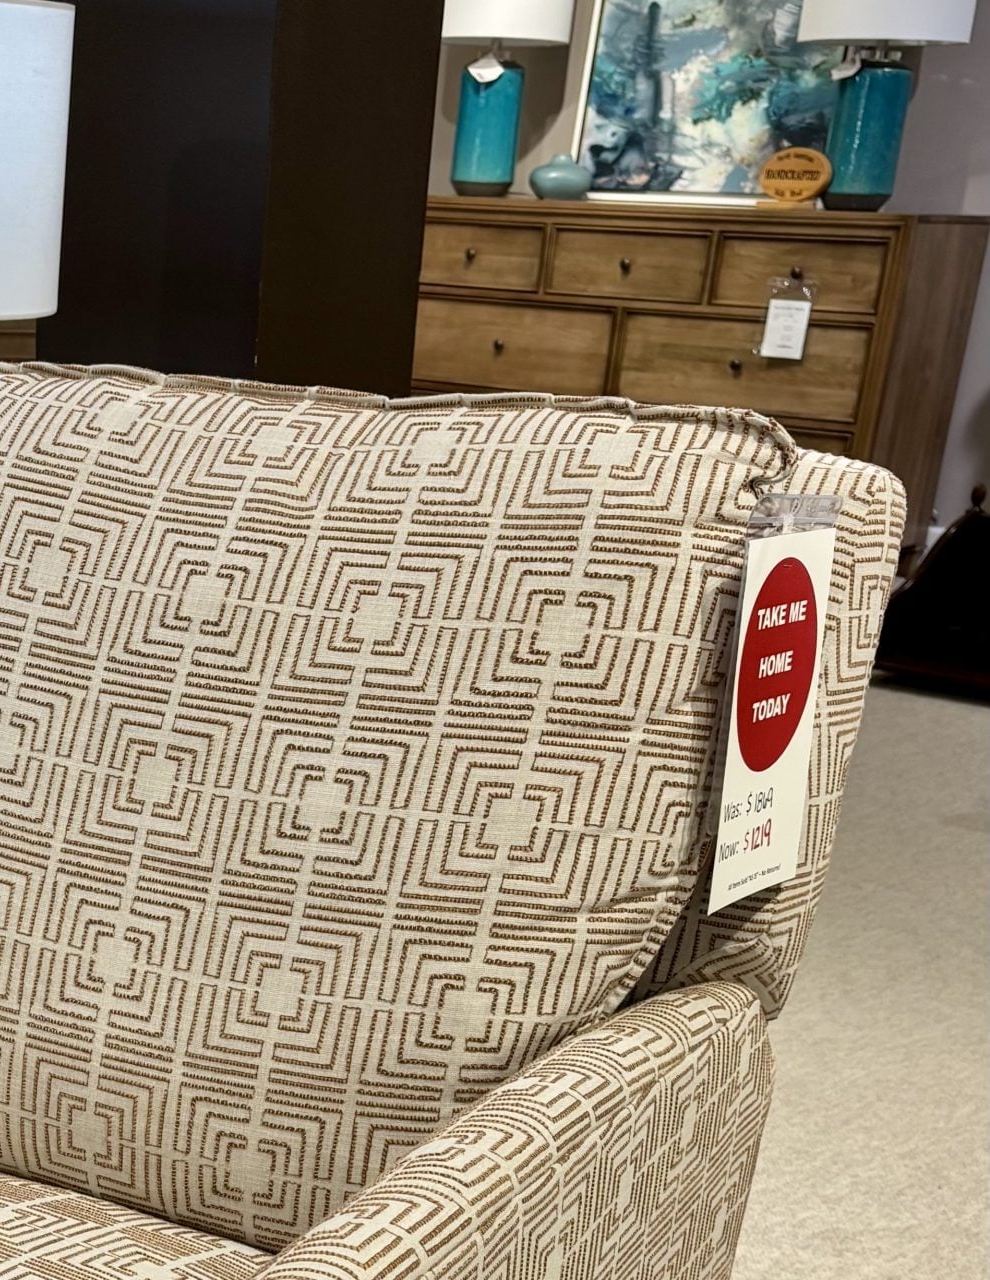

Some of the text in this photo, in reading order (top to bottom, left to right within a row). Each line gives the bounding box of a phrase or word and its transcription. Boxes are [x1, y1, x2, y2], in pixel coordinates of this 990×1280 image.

[757, 599, 808, 631] TAKE ME
[758, 650, 794, 679] HOME
[752, 693, 791, 724] TODAY
[724, 802, 743, 823] Was:
[718, 841, 740, 864] Now:
